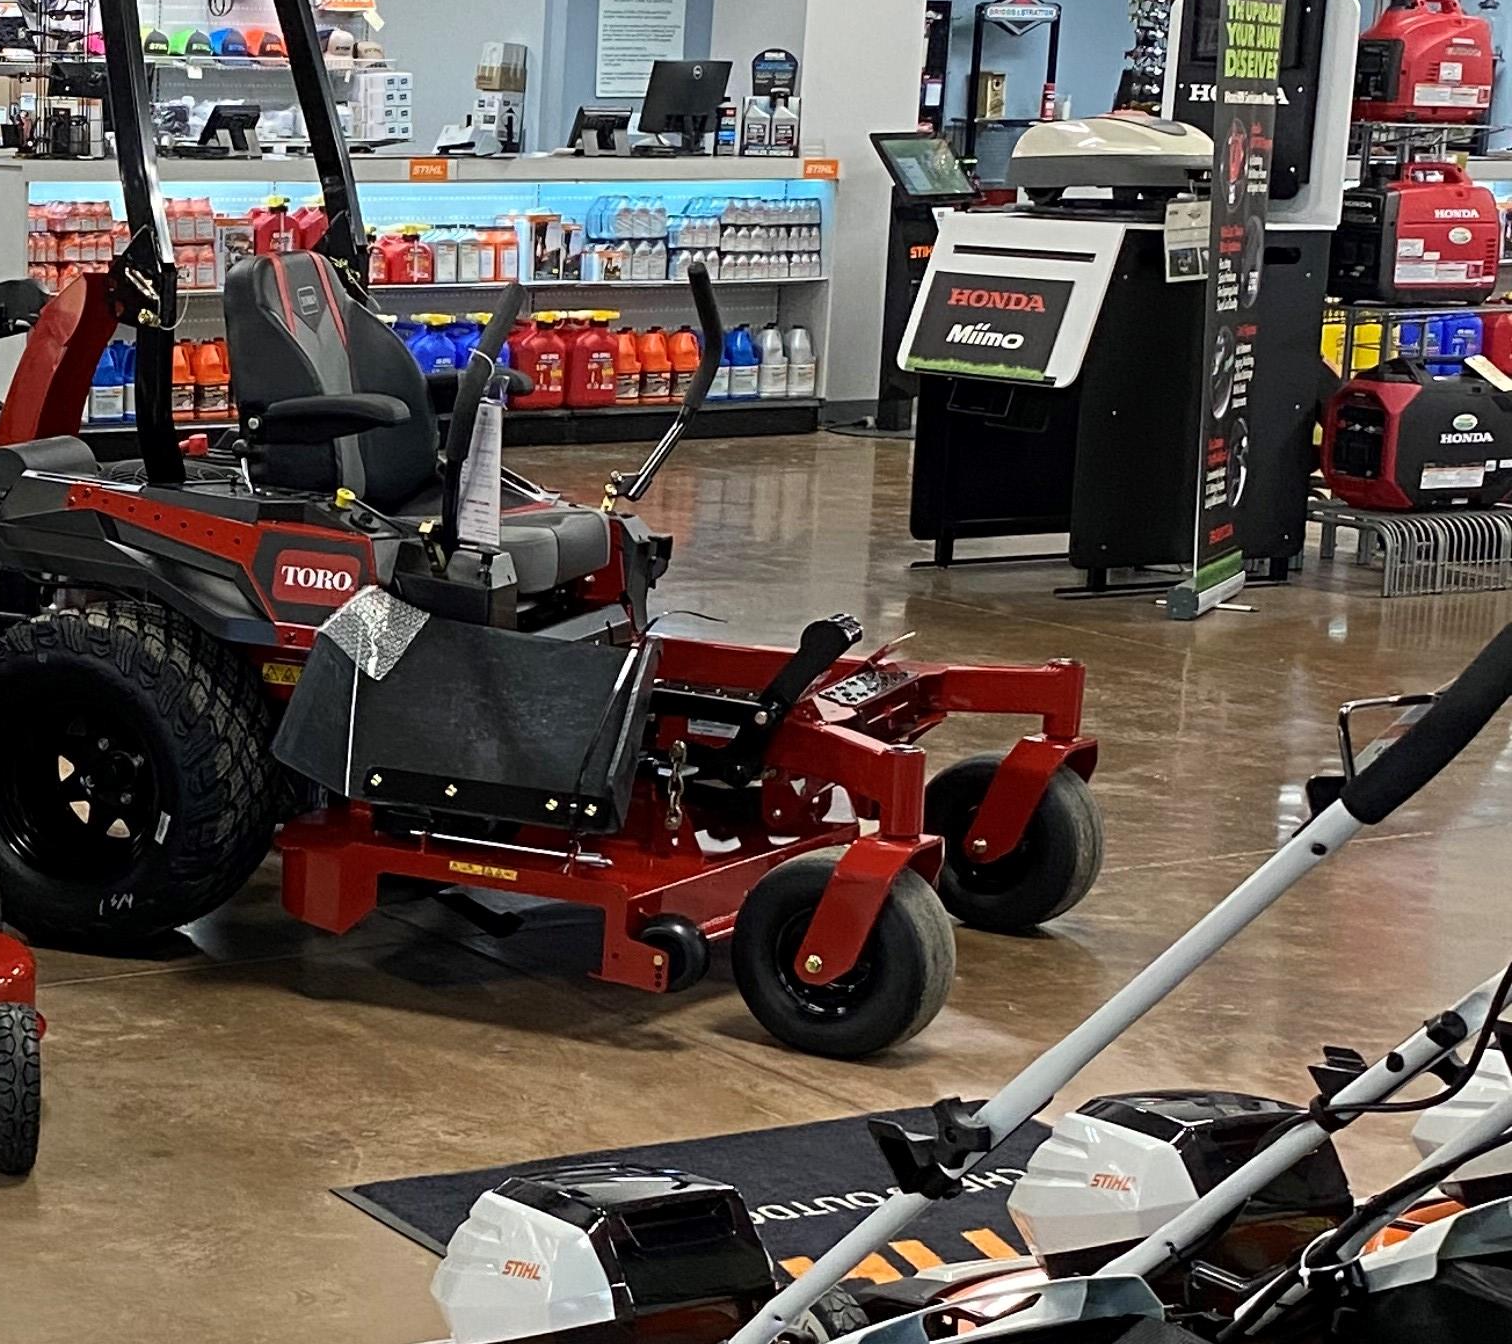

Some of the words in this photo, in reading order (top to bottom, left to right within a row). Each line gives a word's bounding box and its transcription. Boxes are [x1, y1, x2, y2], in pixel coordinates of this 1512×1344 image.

[411, 163, 444, 176] STIHL
[805, 164, 835, 174] STIHL
[1434, 208, 1481, 219] HONDA
[909, 245, 934, 259] STIH
[946, 287, 1046, 313] HONDA
[945, 322, 1025, 350] Miimo
[1439, 431, 1494, 445] HONDA
[281, 564, 355, 592] TORO
[1090, 1172, 1134, 1191] STIHL
[502, 1259, 544, 1281] STIHL
